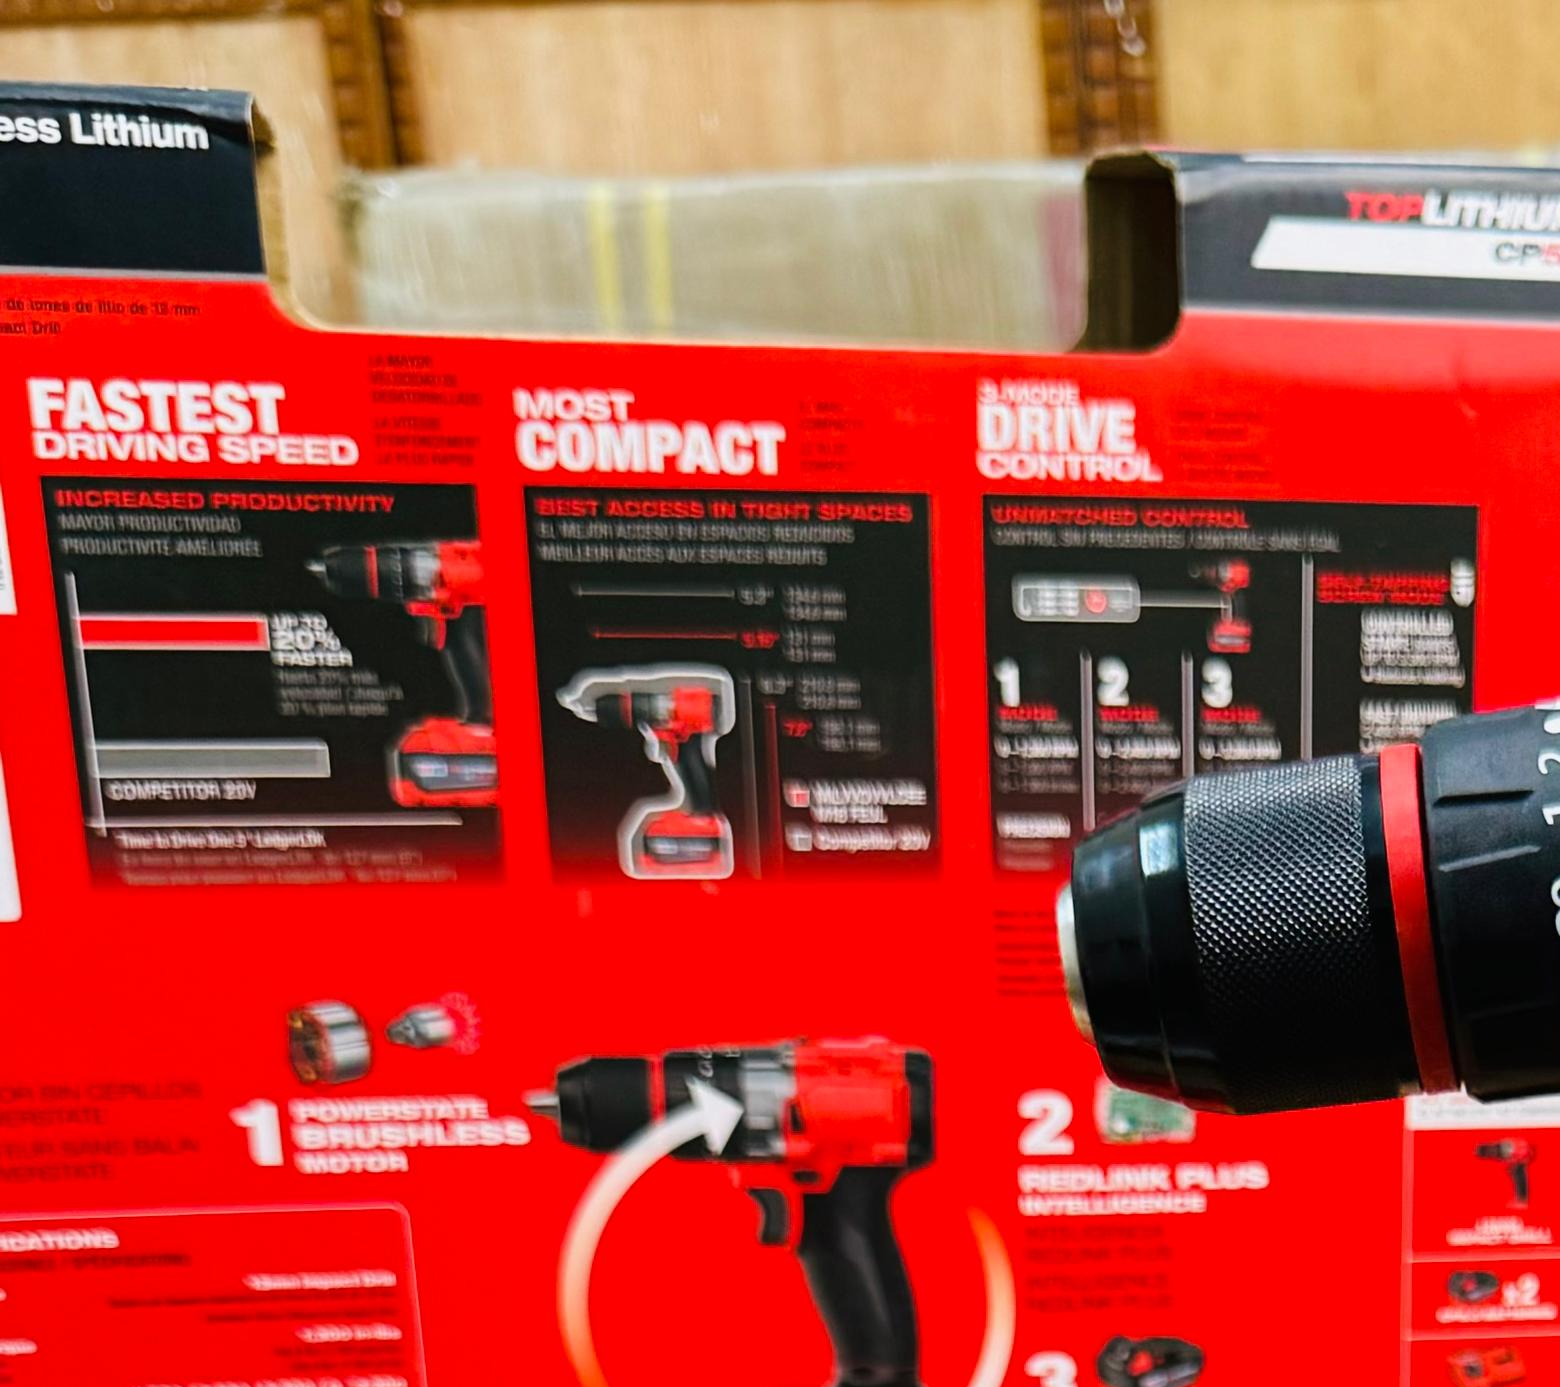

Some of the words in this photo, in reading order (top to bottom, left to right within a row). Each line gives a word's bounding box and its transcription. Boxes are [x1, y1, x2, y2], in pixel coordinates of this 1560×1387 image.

[69, 112, 209, 149] Lithium
[26, 377, 286, 435] FASTEST
[512, 388, 635, 421] MOST
[978, 400, 1136, 453] DRIVE
[33, 431, 209, 463] DRIVING
[218, 434, 360, 466] SPEED
[516, 419, 786, 476] COMPACT
[976, 450, 1163, 483] CONTROL
[55, 490, 204, 509] INCREASED
[211, 493, 394, 512] PRODUCTIVITY
[534, 498, 599, 517] BEST
[606, 499, 705, 518] ACCESS
[711, 500, 735, 519] IN
[741, 501, 811, 520] TIGHT
[818, 503, 912, 522] SPACES
[990, 504, 1137, 526] UNMATCHED
[1142, 507, 1249, 528] CONTROL
[272, 629, 341, 650] 20%
[272, 649, 353, 667] FASTER
[993, 655, 1020, 707] 1
[1097, 655, 1130, 706] 2
[1202, 656, 1233, 708] 3
[106, 780, 219, 800] COMPETITOR
[289, 1094, 489, 1121] POWERSTATE
[1018, 1090, 1074, 1155] 2
[229, 1098, 283, 1166] 1
[290, 1119, 531, 1149] BRUSHLESS
[294, 1150, 408, 1174] MOTOR
[1018, 1164, 1171, 1193] REDLINK
[1175, 1161, 1269, 1190] PLUS
[1018, 1190, 1207, 1216] INTELLIGENCE
